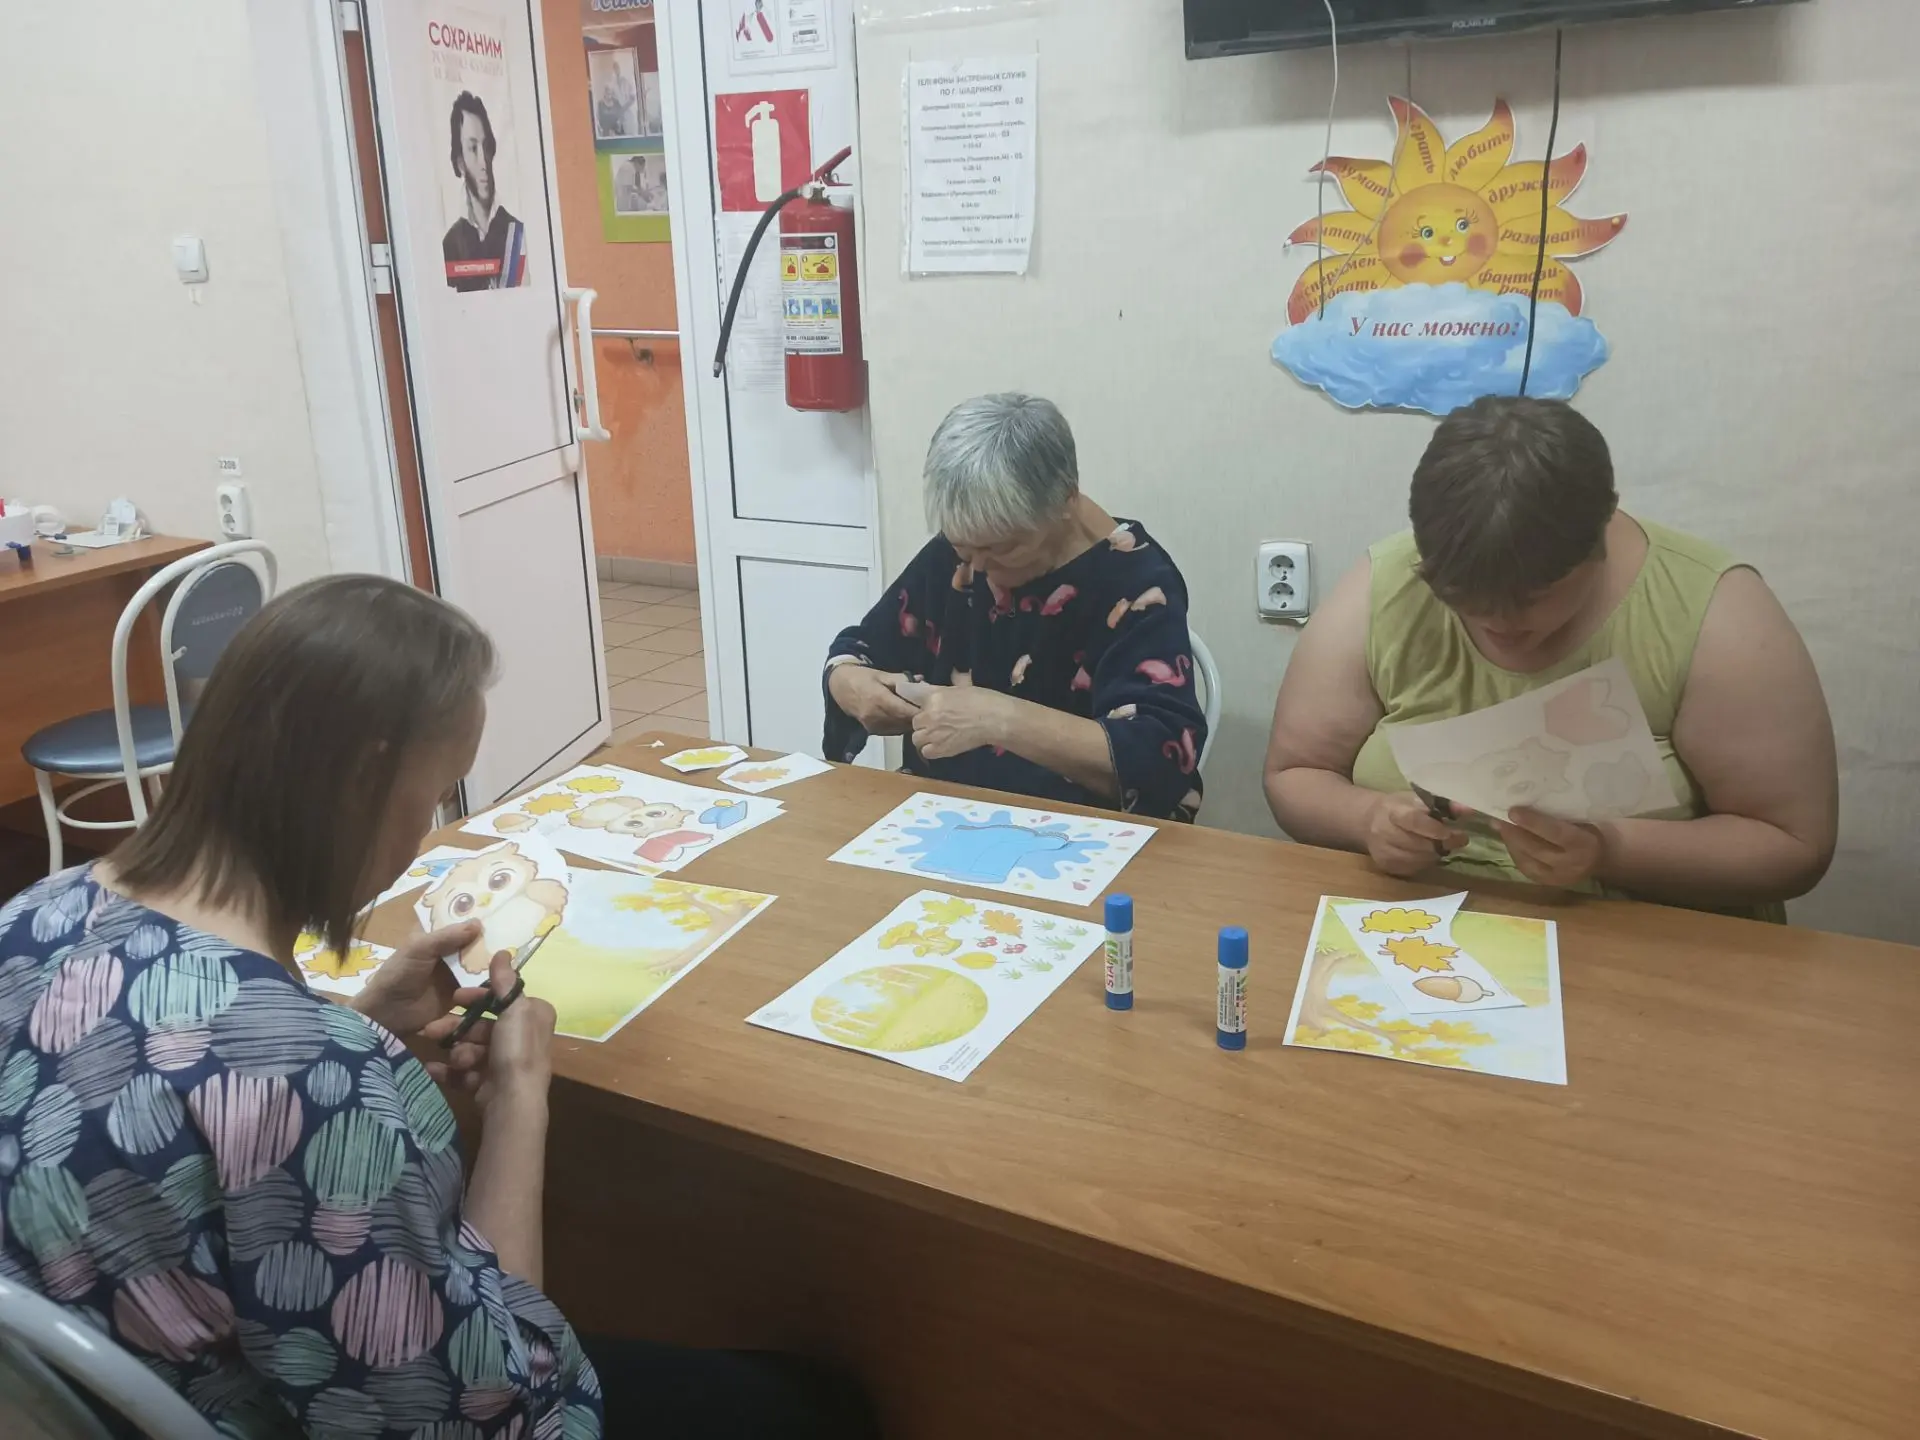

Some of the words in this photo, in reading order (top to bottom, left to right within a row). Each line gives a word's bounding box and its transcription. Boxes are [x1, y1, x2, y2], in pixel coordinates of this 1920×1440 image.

[428, 21, 503, 60] СОХРАНИМ
[1409, 122, 1437, 174] грать
[1449, 130, 1511, 182] любить
[1348, 316, 1368, 337] У
[1372, 321, 1414, 337] нас
[1418, 320, 1520, 337] можно:
